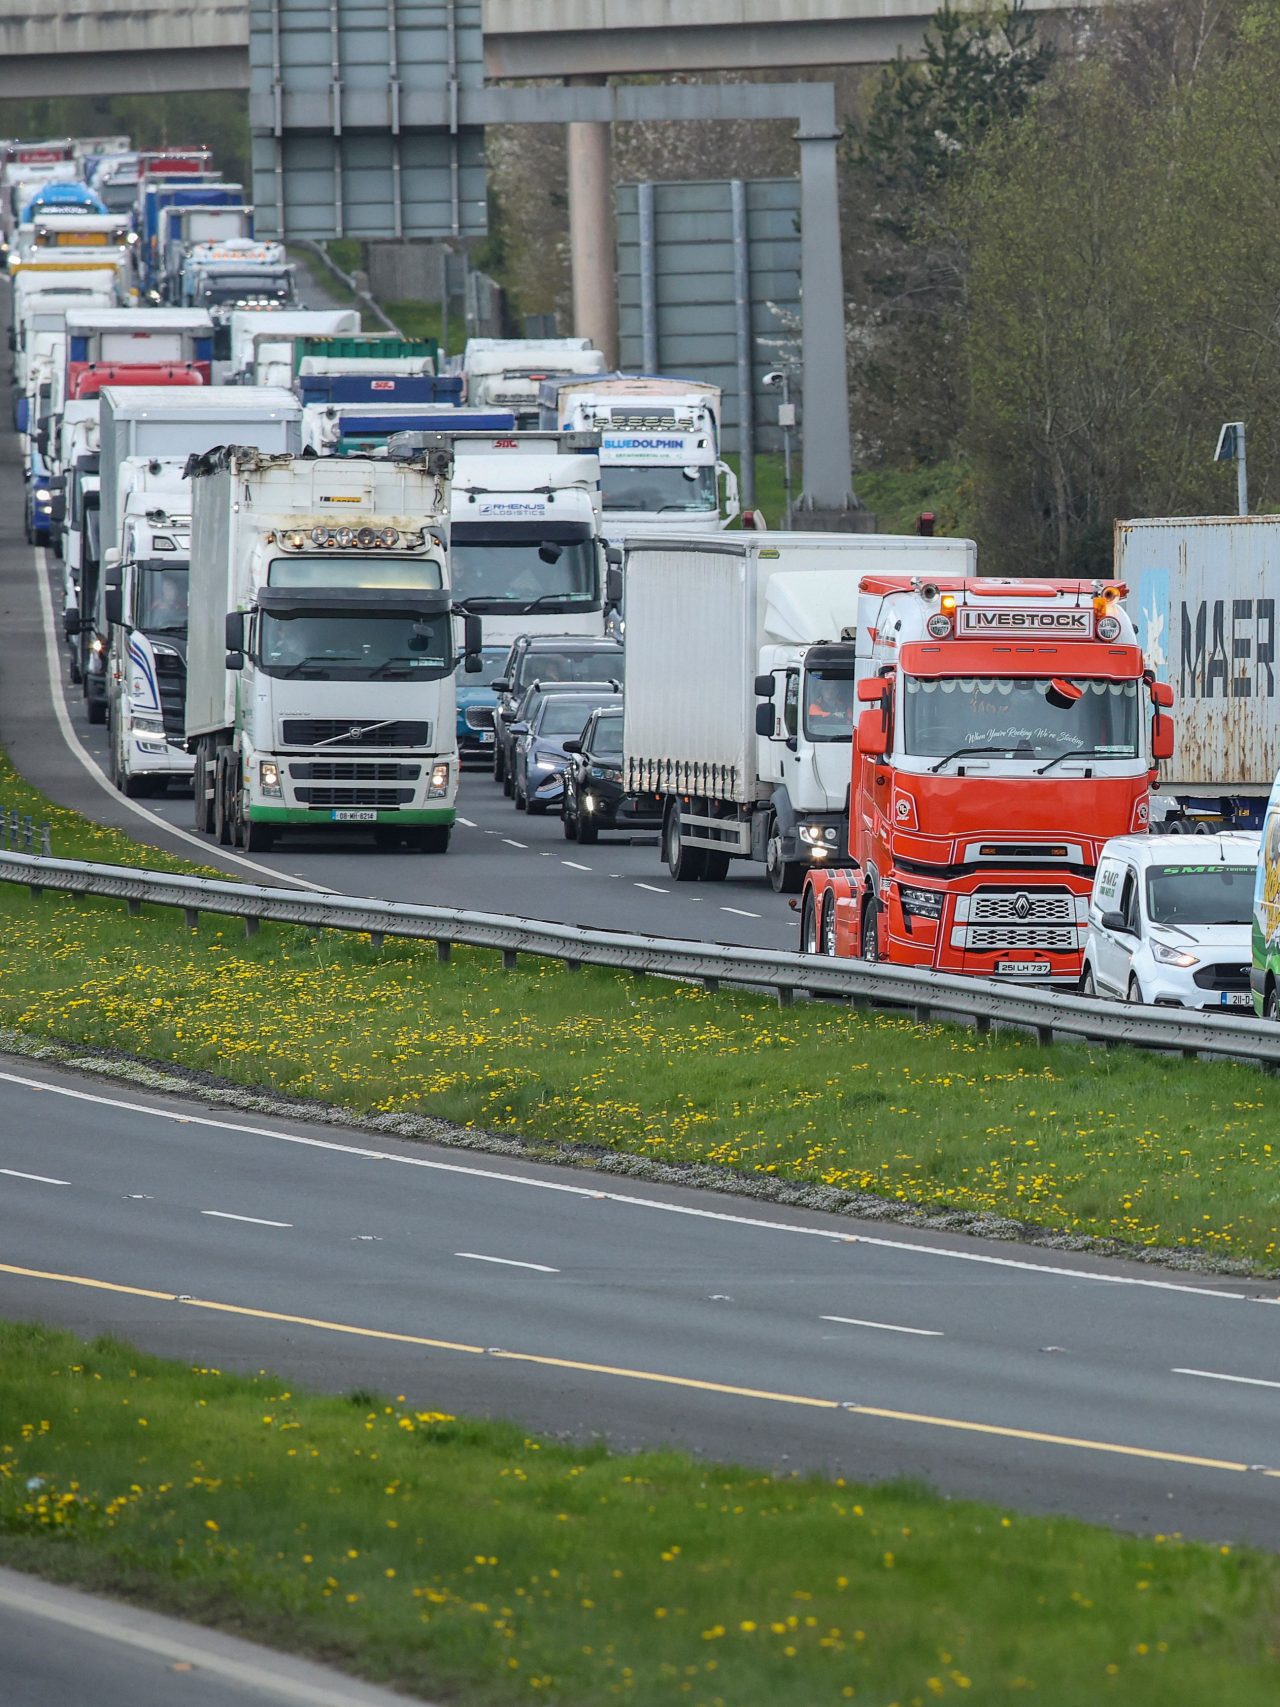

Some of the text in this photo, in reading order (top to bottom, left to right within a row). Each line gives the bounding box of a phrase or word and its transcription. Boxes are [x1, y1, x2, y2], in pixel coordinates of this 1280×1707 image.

[965, 612, 1086, 629] LIVESTOCK
[1163, 866, 1225, 874] SMC
[1101, 870, 1119, 887] SMC
[1017, 964, 1029, 972] LH
[1031, 964, 1048, 972] 737
